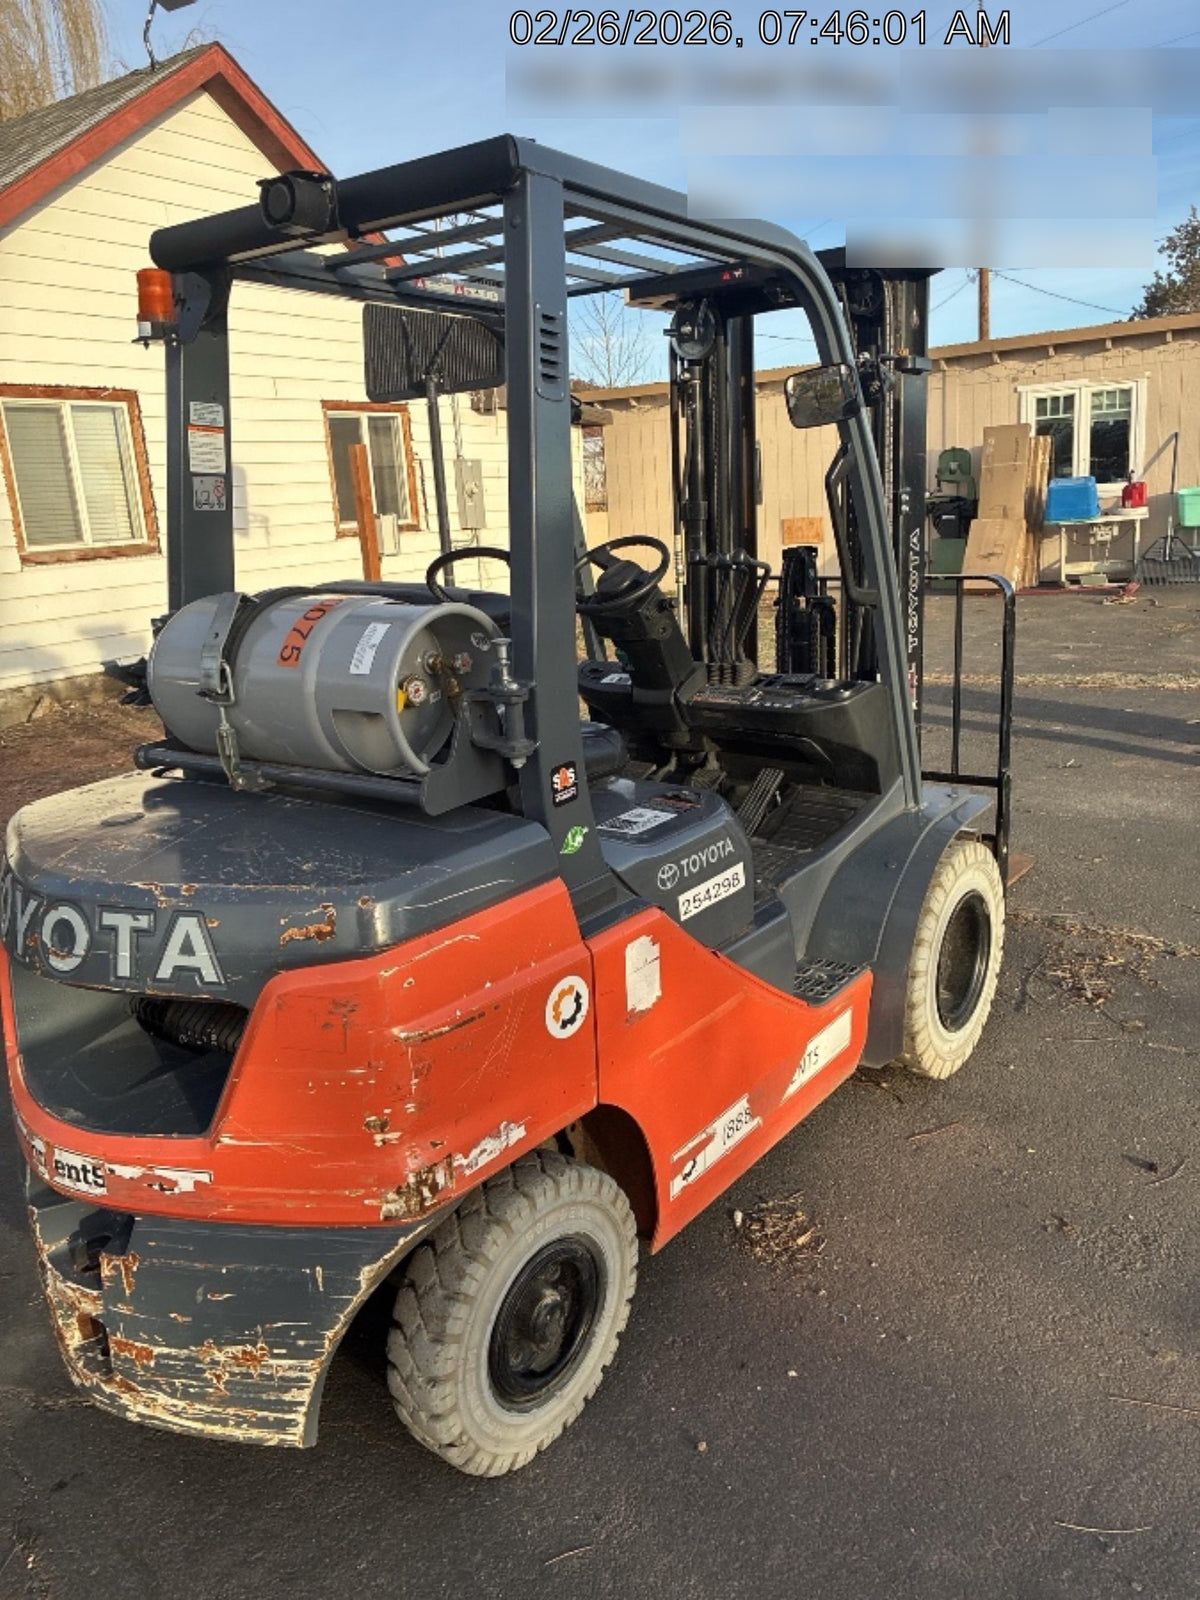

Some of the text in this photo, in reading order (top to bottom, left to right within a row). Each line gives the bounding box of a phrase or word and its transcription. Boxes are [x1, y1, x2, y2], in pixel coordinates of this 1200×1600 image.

[907, 527, 921, 653] TOYOTA
[680, 837, 735, 878] TOYOTA
[681, 871, 741, 917] 254298
